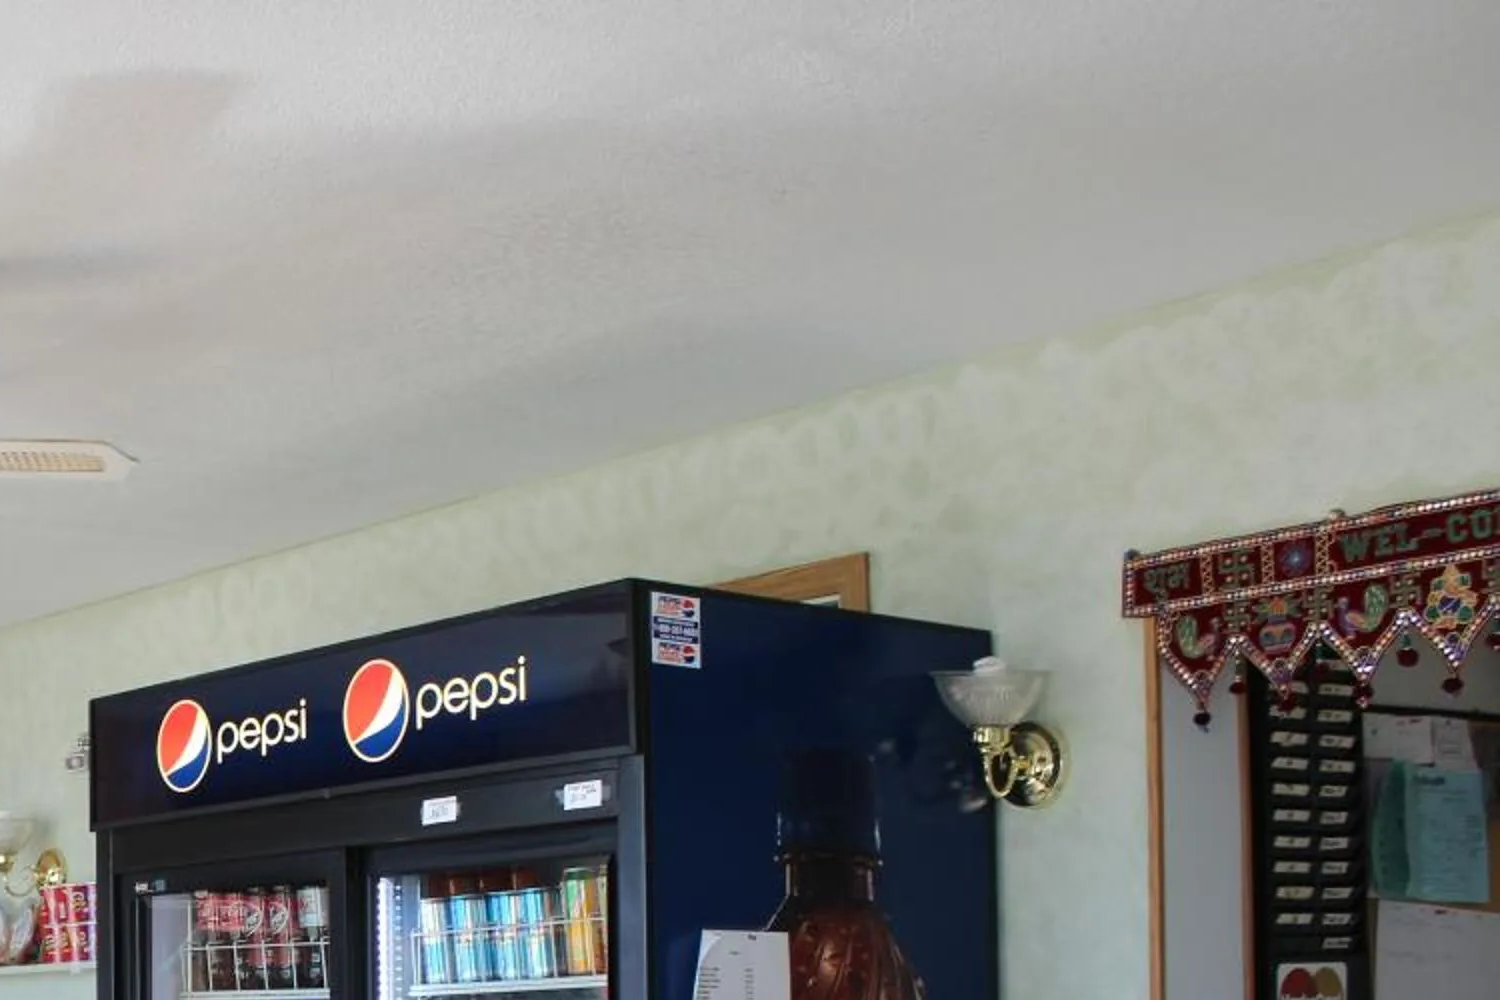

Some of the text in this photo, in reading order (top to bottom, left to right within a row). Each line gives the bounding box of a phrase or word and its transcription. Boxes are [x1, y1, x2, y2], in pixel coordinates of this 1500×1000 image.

[1340, 507, 1500, 562] WEL-CO
[416, 655, 527, 730] pepsi
[217, 698, 306, 764] pepsi
